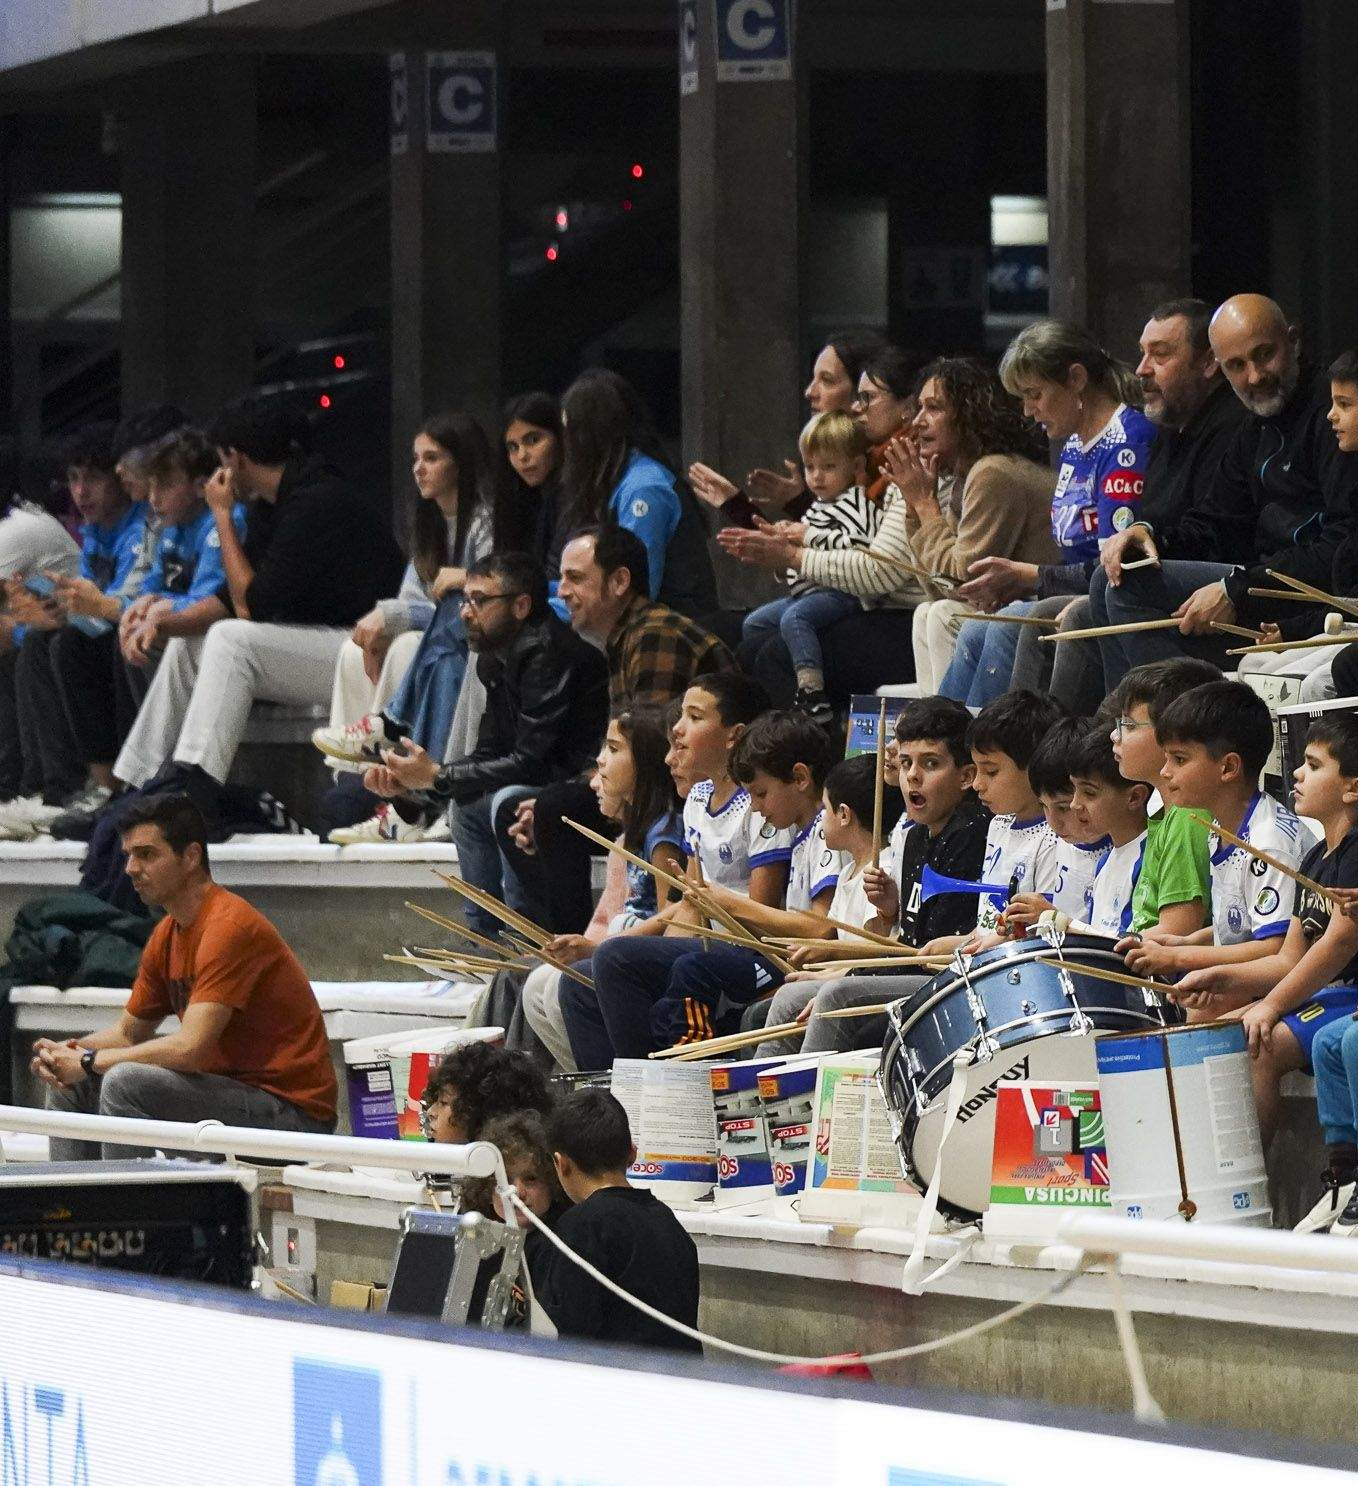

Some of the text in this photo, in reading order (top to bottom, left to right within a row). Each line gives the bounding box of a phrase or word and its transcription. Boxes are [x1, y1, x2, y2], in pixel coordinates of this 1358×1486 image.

[727, 0, 776, 50] C
[438, 75, 484, 124] C
[1104, 478, 1144, 496] AC&C
[725, 1121, 751, 1130] STOP
[778, 1127, 803, 1137] STOP
[1047, 1172, 1080, 1186] Sport
